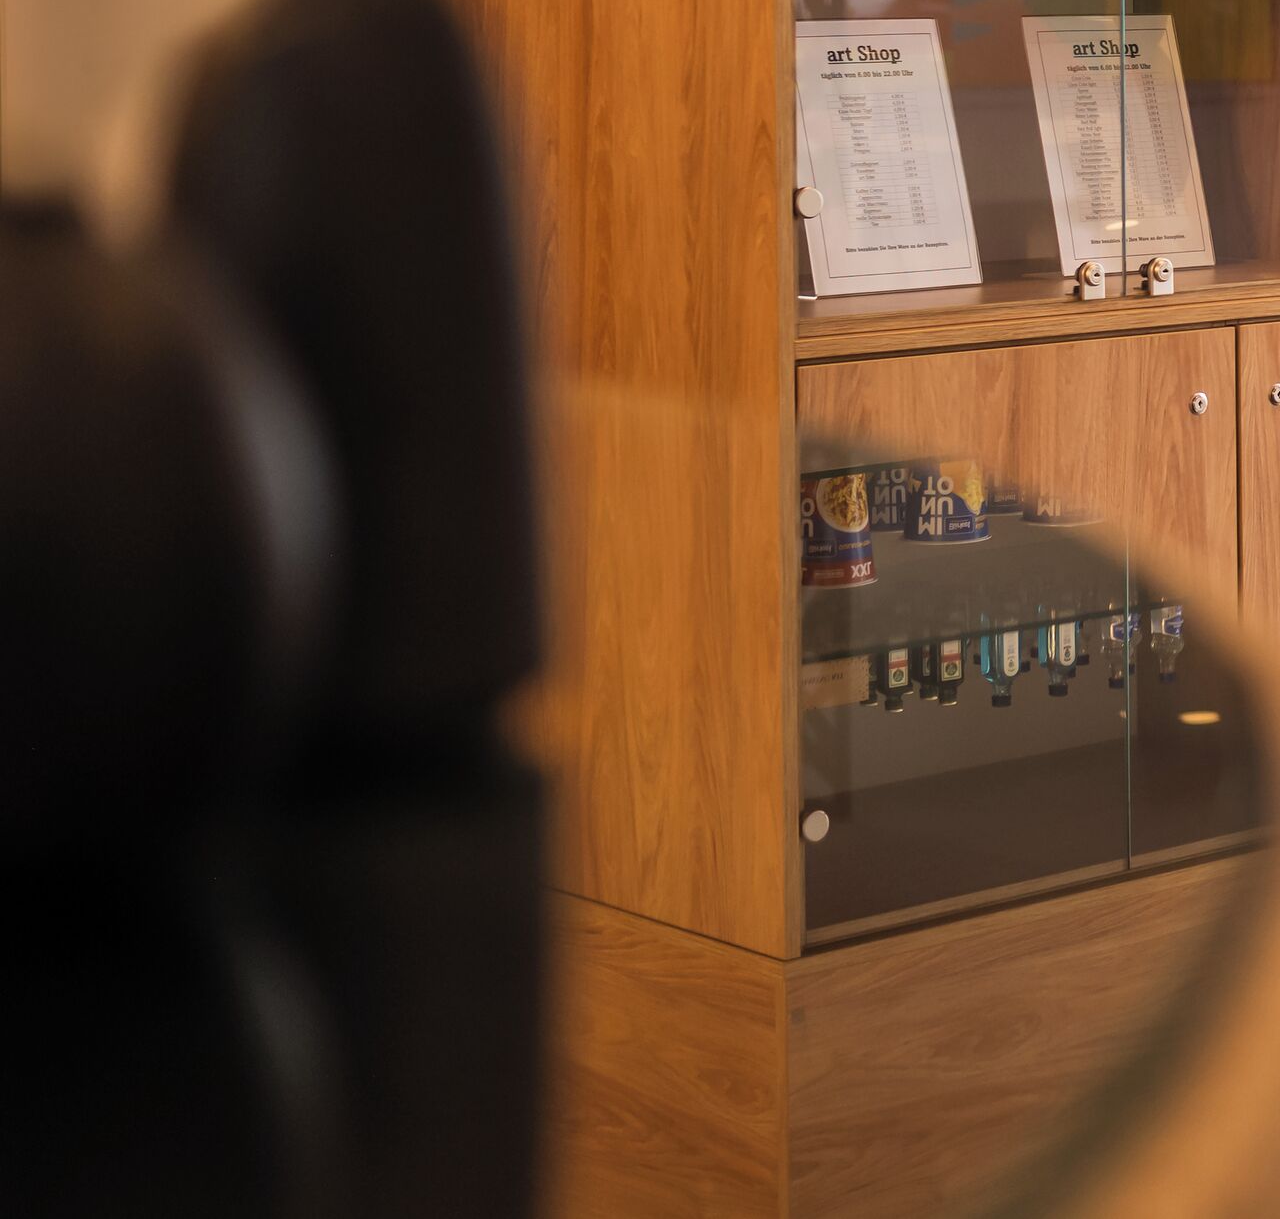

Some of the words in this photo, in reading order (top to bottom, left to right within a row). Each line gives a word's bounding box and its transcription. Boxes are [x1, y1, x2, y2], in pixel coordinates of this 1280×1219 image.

[827, 47, 853, 62] art
[857, 45, 901, 64] Shop
[1073, 41, 1096, 55] art
[821, 72, 843, 80] täglich
